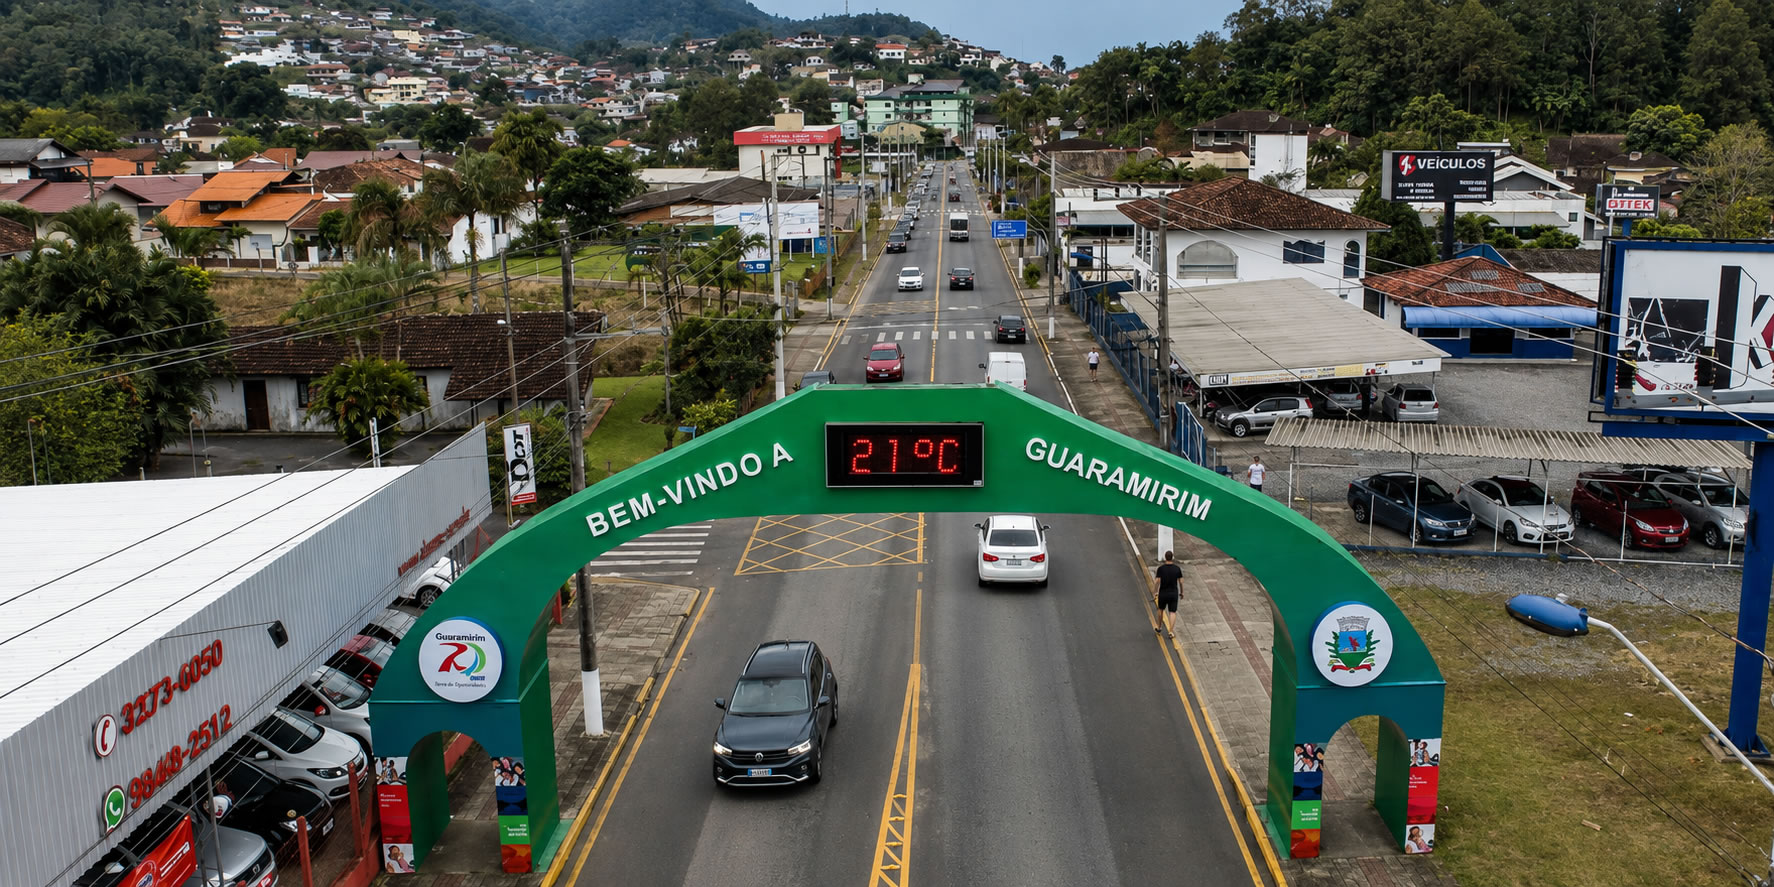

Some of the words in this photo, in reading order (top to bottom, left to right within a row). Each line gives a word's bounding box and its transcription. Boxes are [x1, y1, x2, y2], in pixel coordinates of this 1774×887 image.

[585, 453, 762, 537] BEM-VINDO
[773, 442, 794, 468] A
[1026, 437, 1212, 521] GUARAMIRIM
